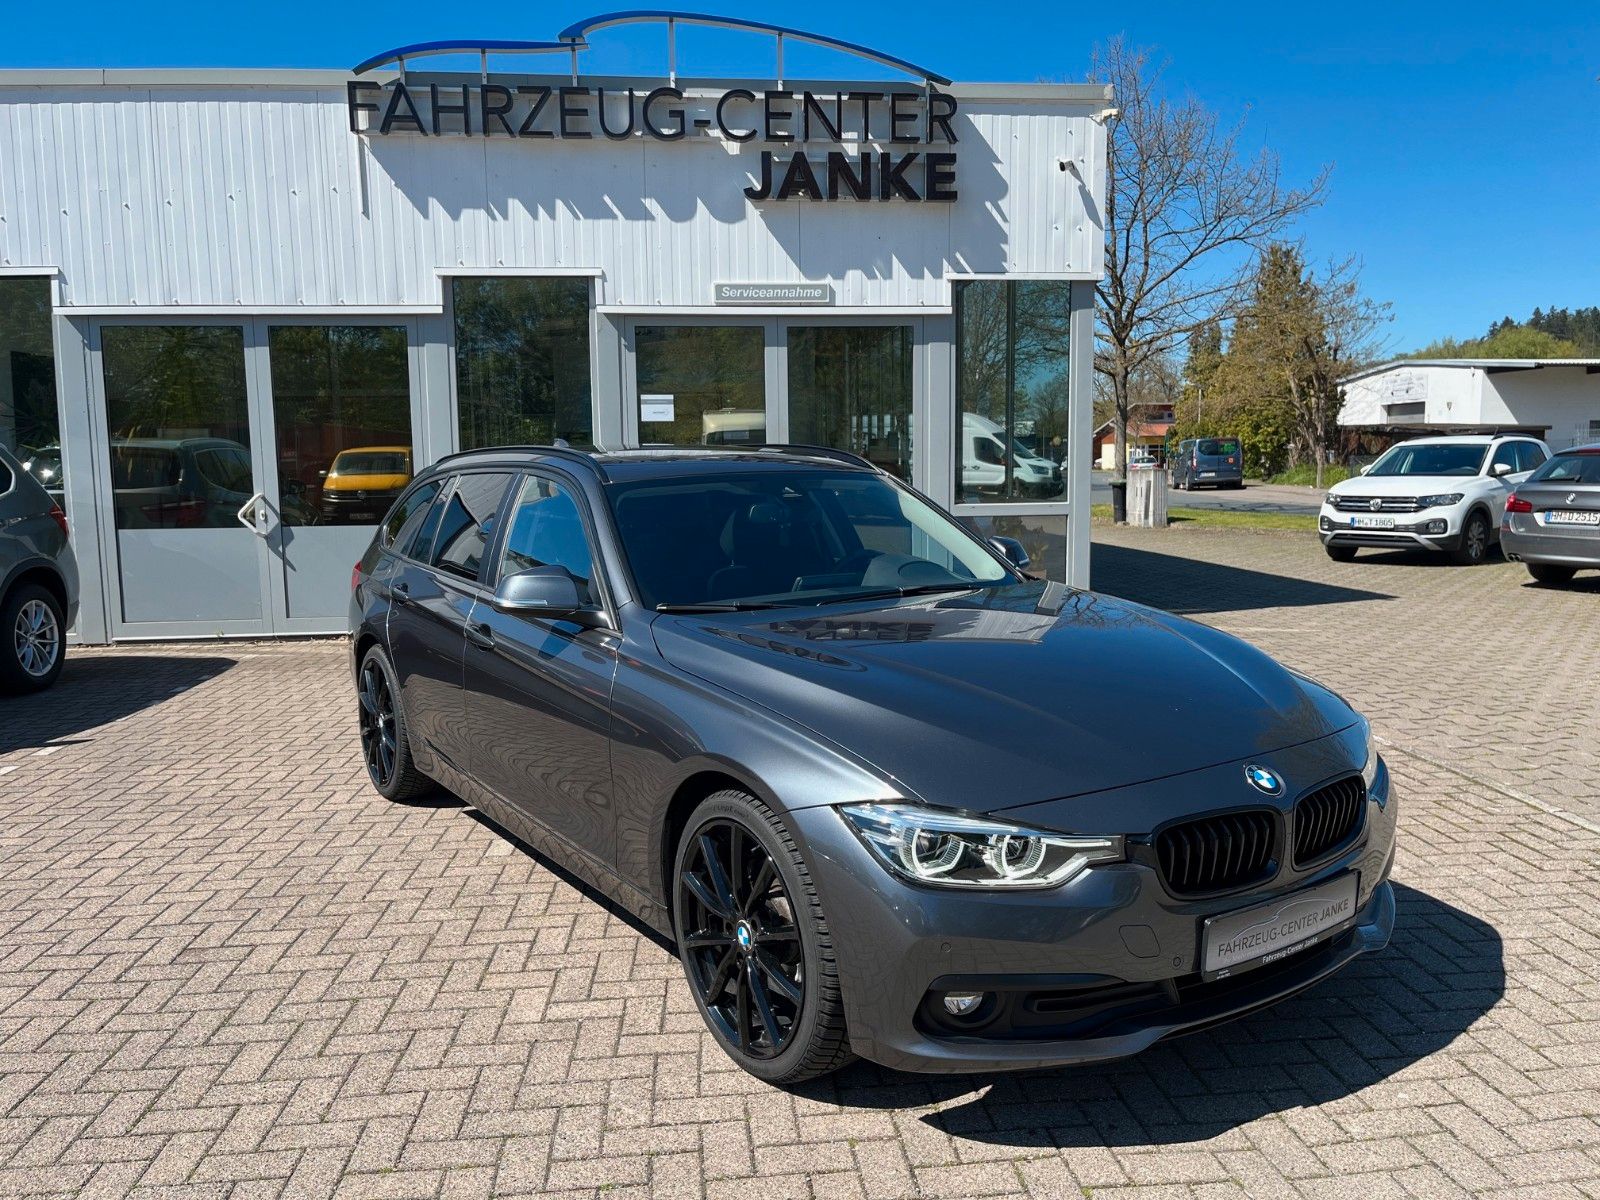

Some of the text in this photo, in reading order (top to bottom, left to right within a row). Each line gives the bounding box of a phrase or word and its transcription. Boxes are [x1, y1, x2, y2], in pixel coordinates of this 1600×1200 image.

[347, 80, 959, 145] FAHRZEUG-CENTER
[743, 151, 958, 203] JANKE
[721, 286, 822, 298] Serviceannahme
[1575, 512, 1599, 522] 2515
[1218, 911, 1318, 957] FAHRZEUG-CENTER
[1320, 898, 1349, 921] JANKE
